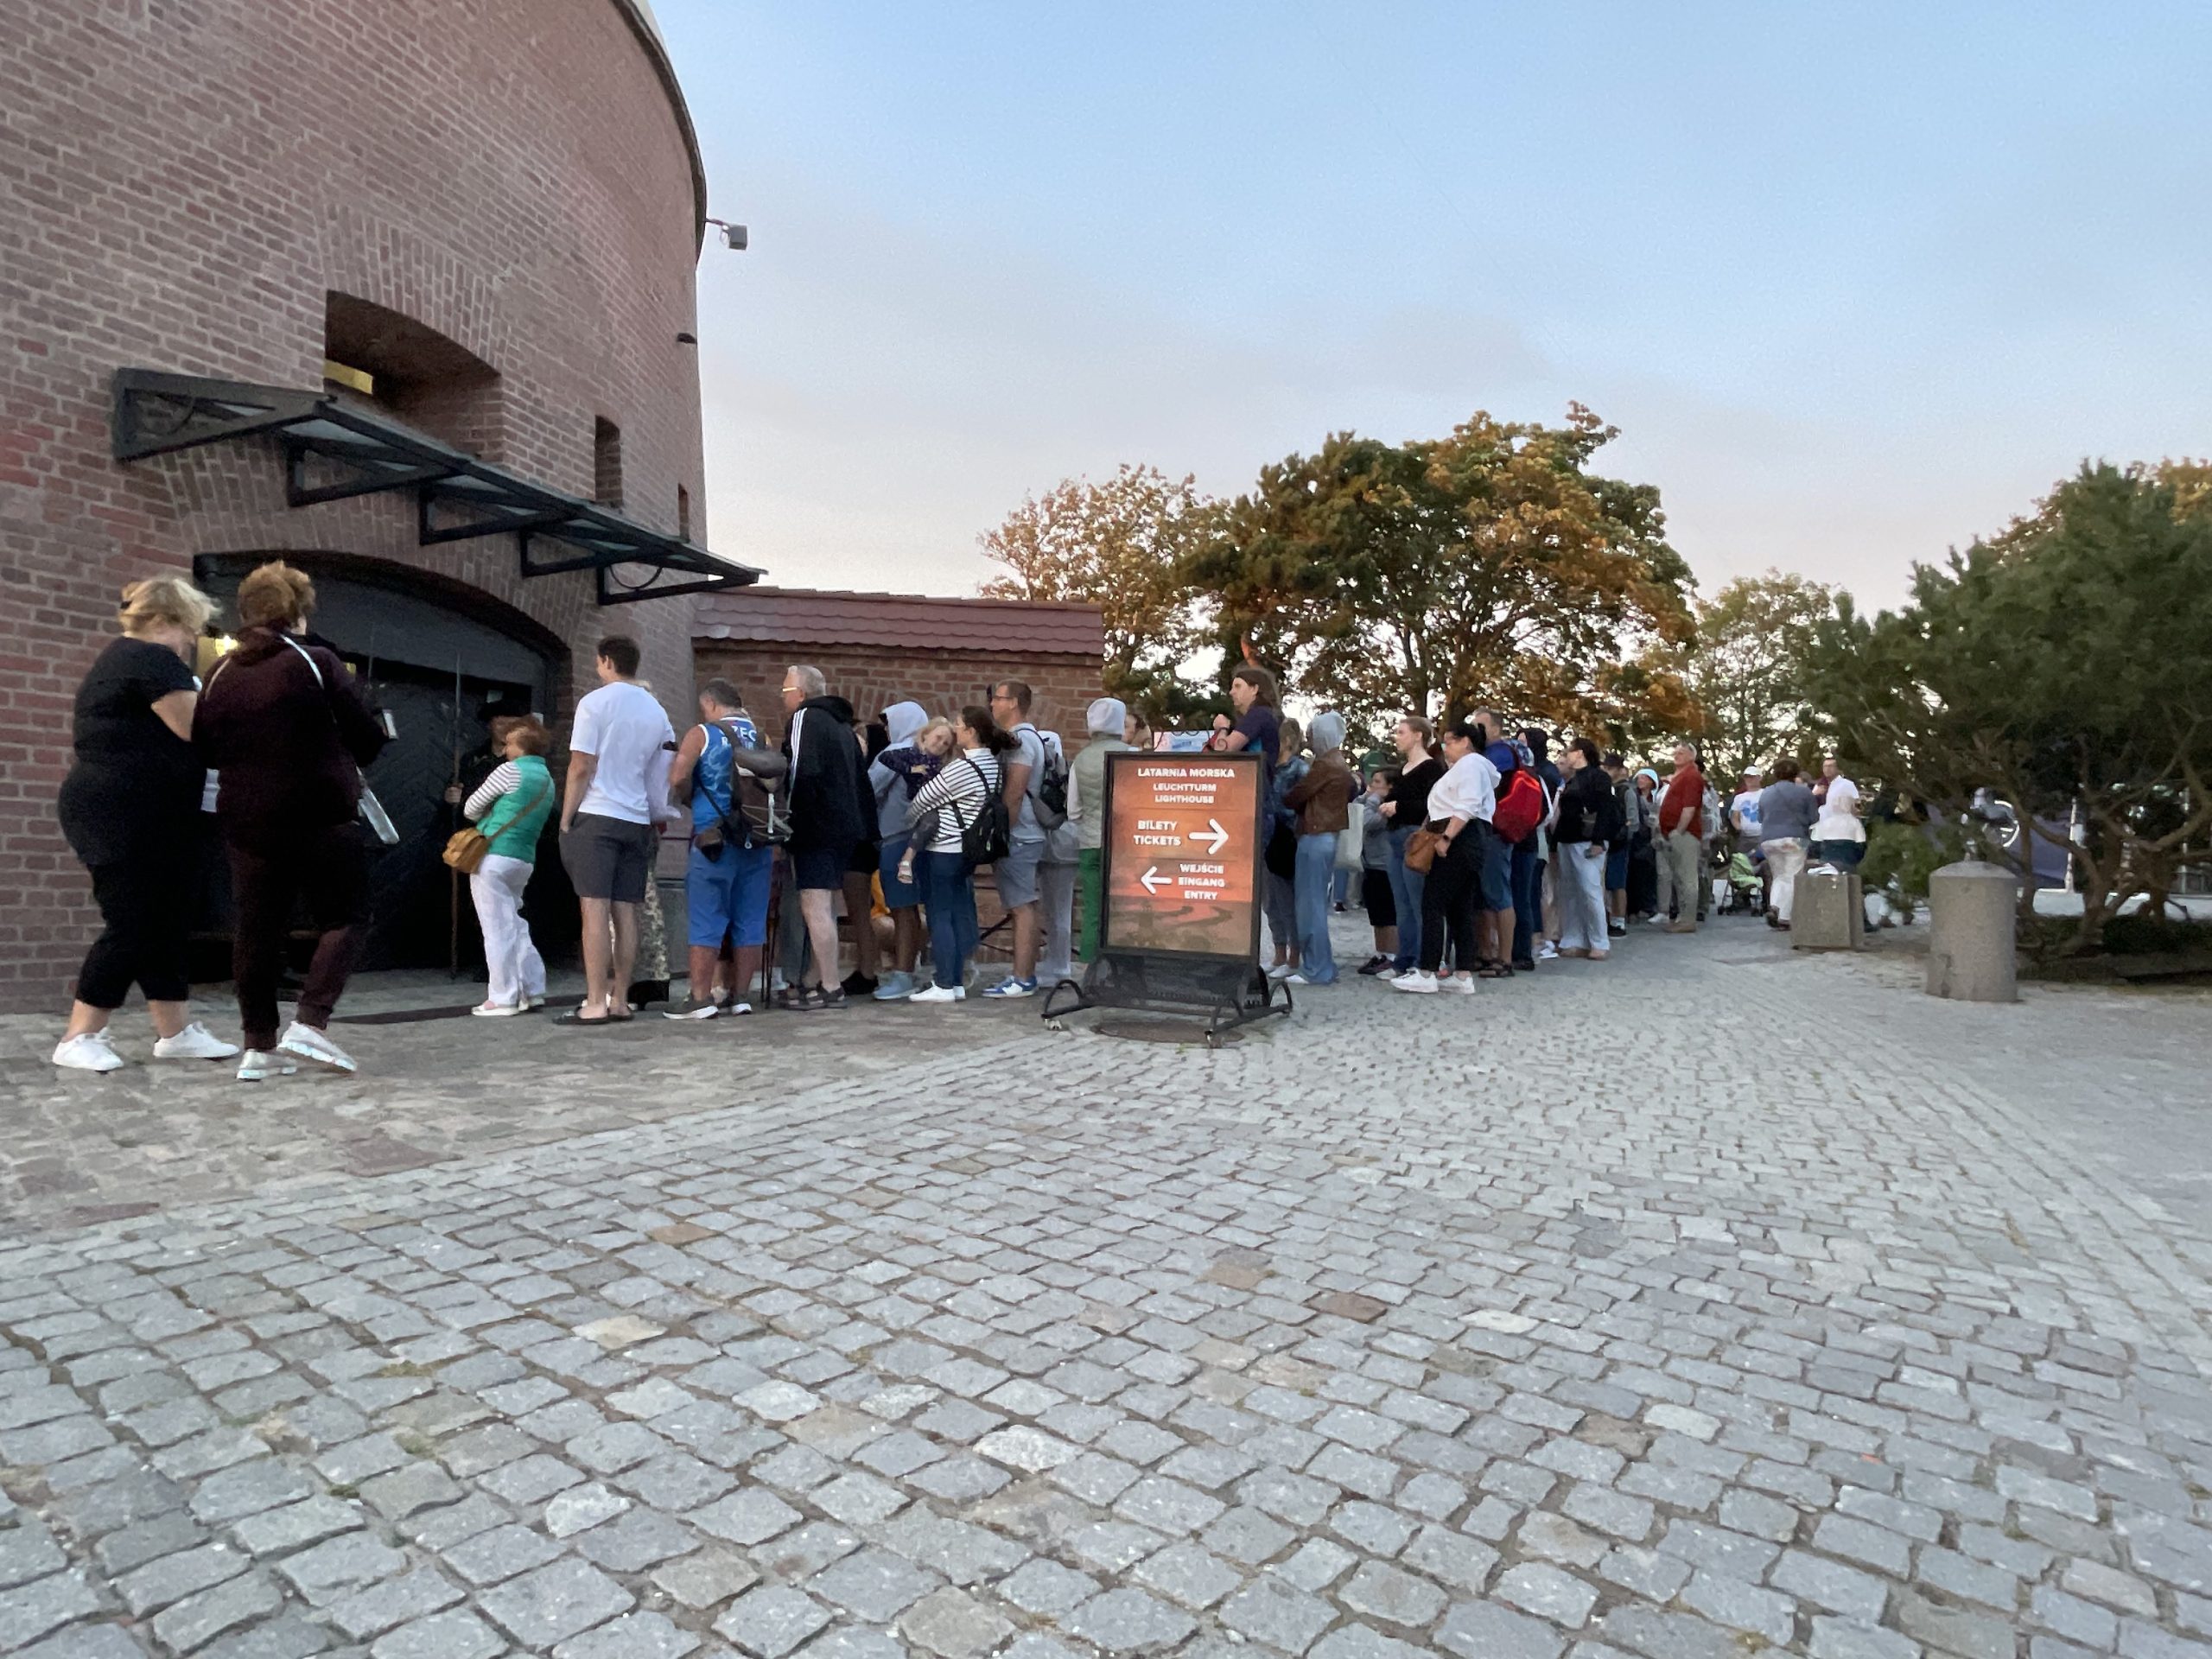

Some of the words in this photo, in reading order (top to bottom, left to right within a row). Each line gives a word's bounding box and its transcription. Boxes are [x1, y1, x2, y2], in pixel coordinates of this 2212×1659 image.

[1138, 767, 1186, 778] LATARNIA
[1190, 768, 1235, 778] MORSKA
[1153, 783, 1217, 791] LEUCHTTURM
[1155, 794, 1214, 804] LIGHTHOUSE
[1138, 820, 1178, 830] BILETY
[1134, 835, 1181, 846] TICKETS
[1179, 862, 1224, 874] WEJŚCIE
[1179, 876, 1225, 887] EINGANG
[1185, 891, 1218, 900] ENTRY
